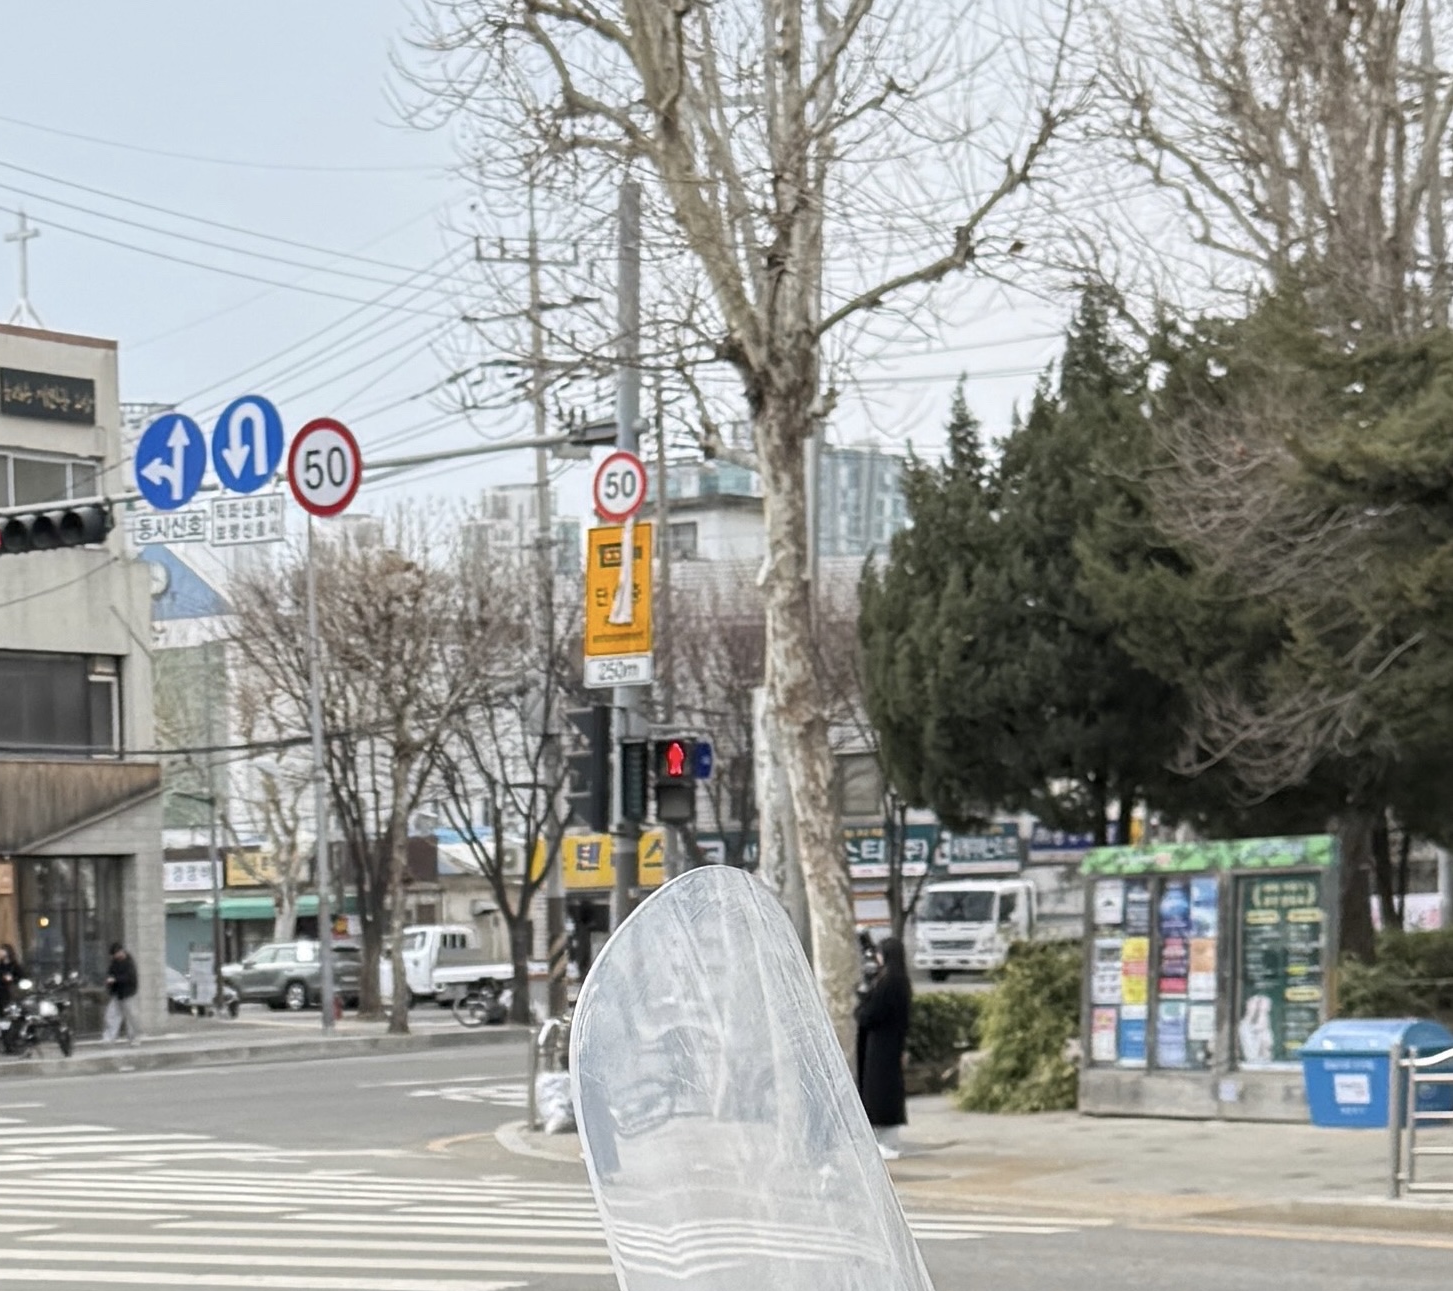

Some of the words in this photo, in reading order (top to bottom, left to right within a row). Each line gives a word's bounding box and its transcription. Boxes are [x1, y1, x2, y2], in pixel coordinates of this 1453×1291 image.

[304, 446, 347, 490] 50
[604, 470, 637, 500] 50
[138, 515, 202, 541] 동시신호
